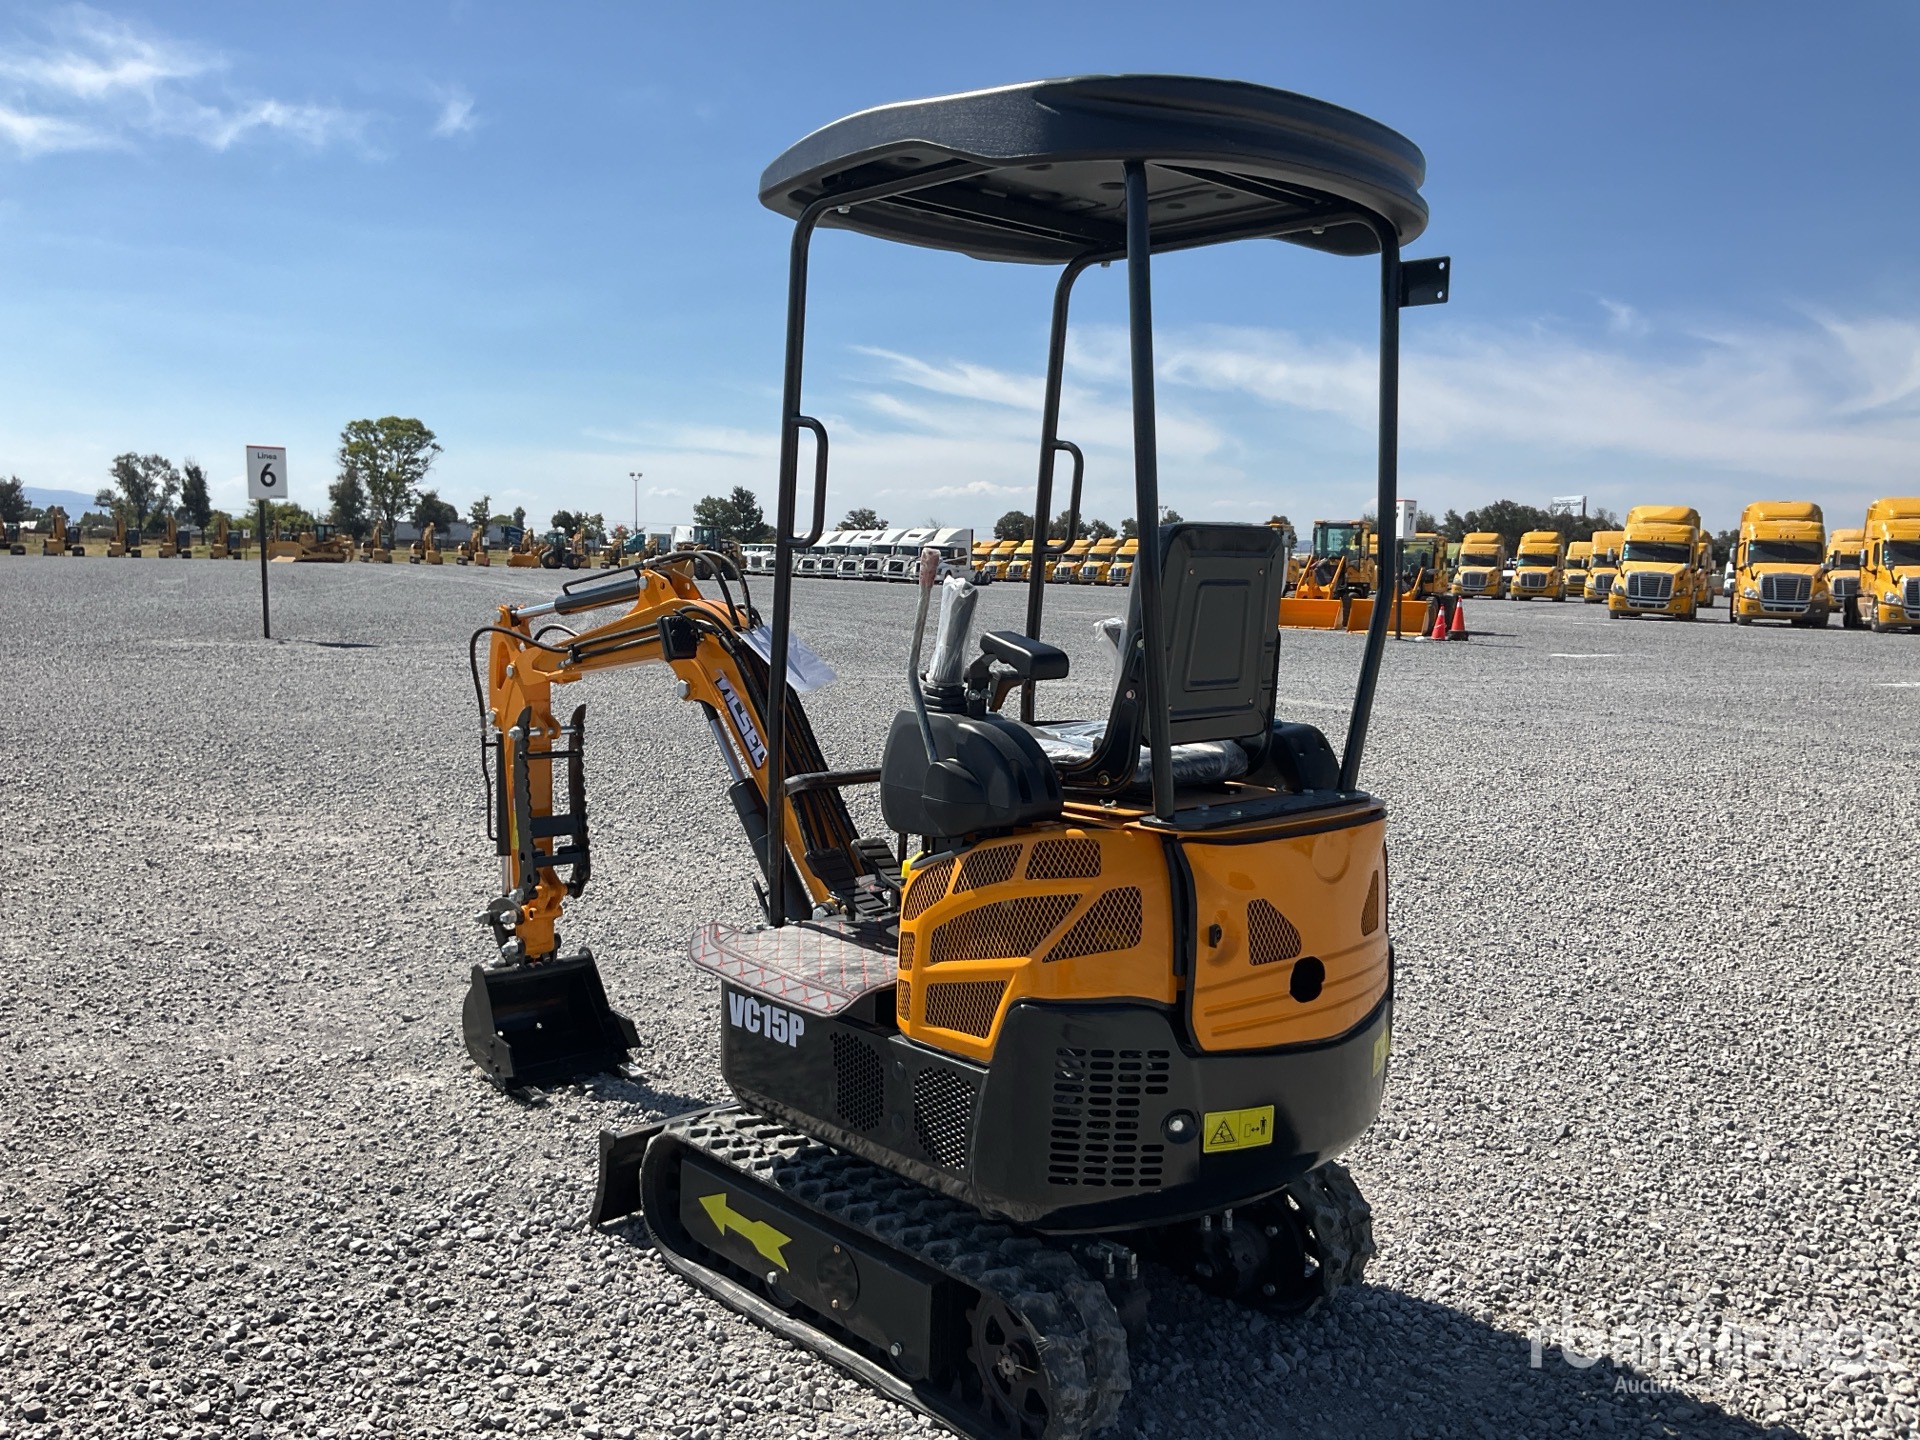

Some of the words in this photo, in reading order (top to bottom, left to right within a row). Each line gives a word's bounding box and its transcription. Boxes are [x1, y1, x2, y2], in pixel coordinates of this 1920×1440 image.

[260, 463, 276, 487] 6
[1408, 513, 1414, 530] 7
[728, 991, 804, 1048] VC15P
